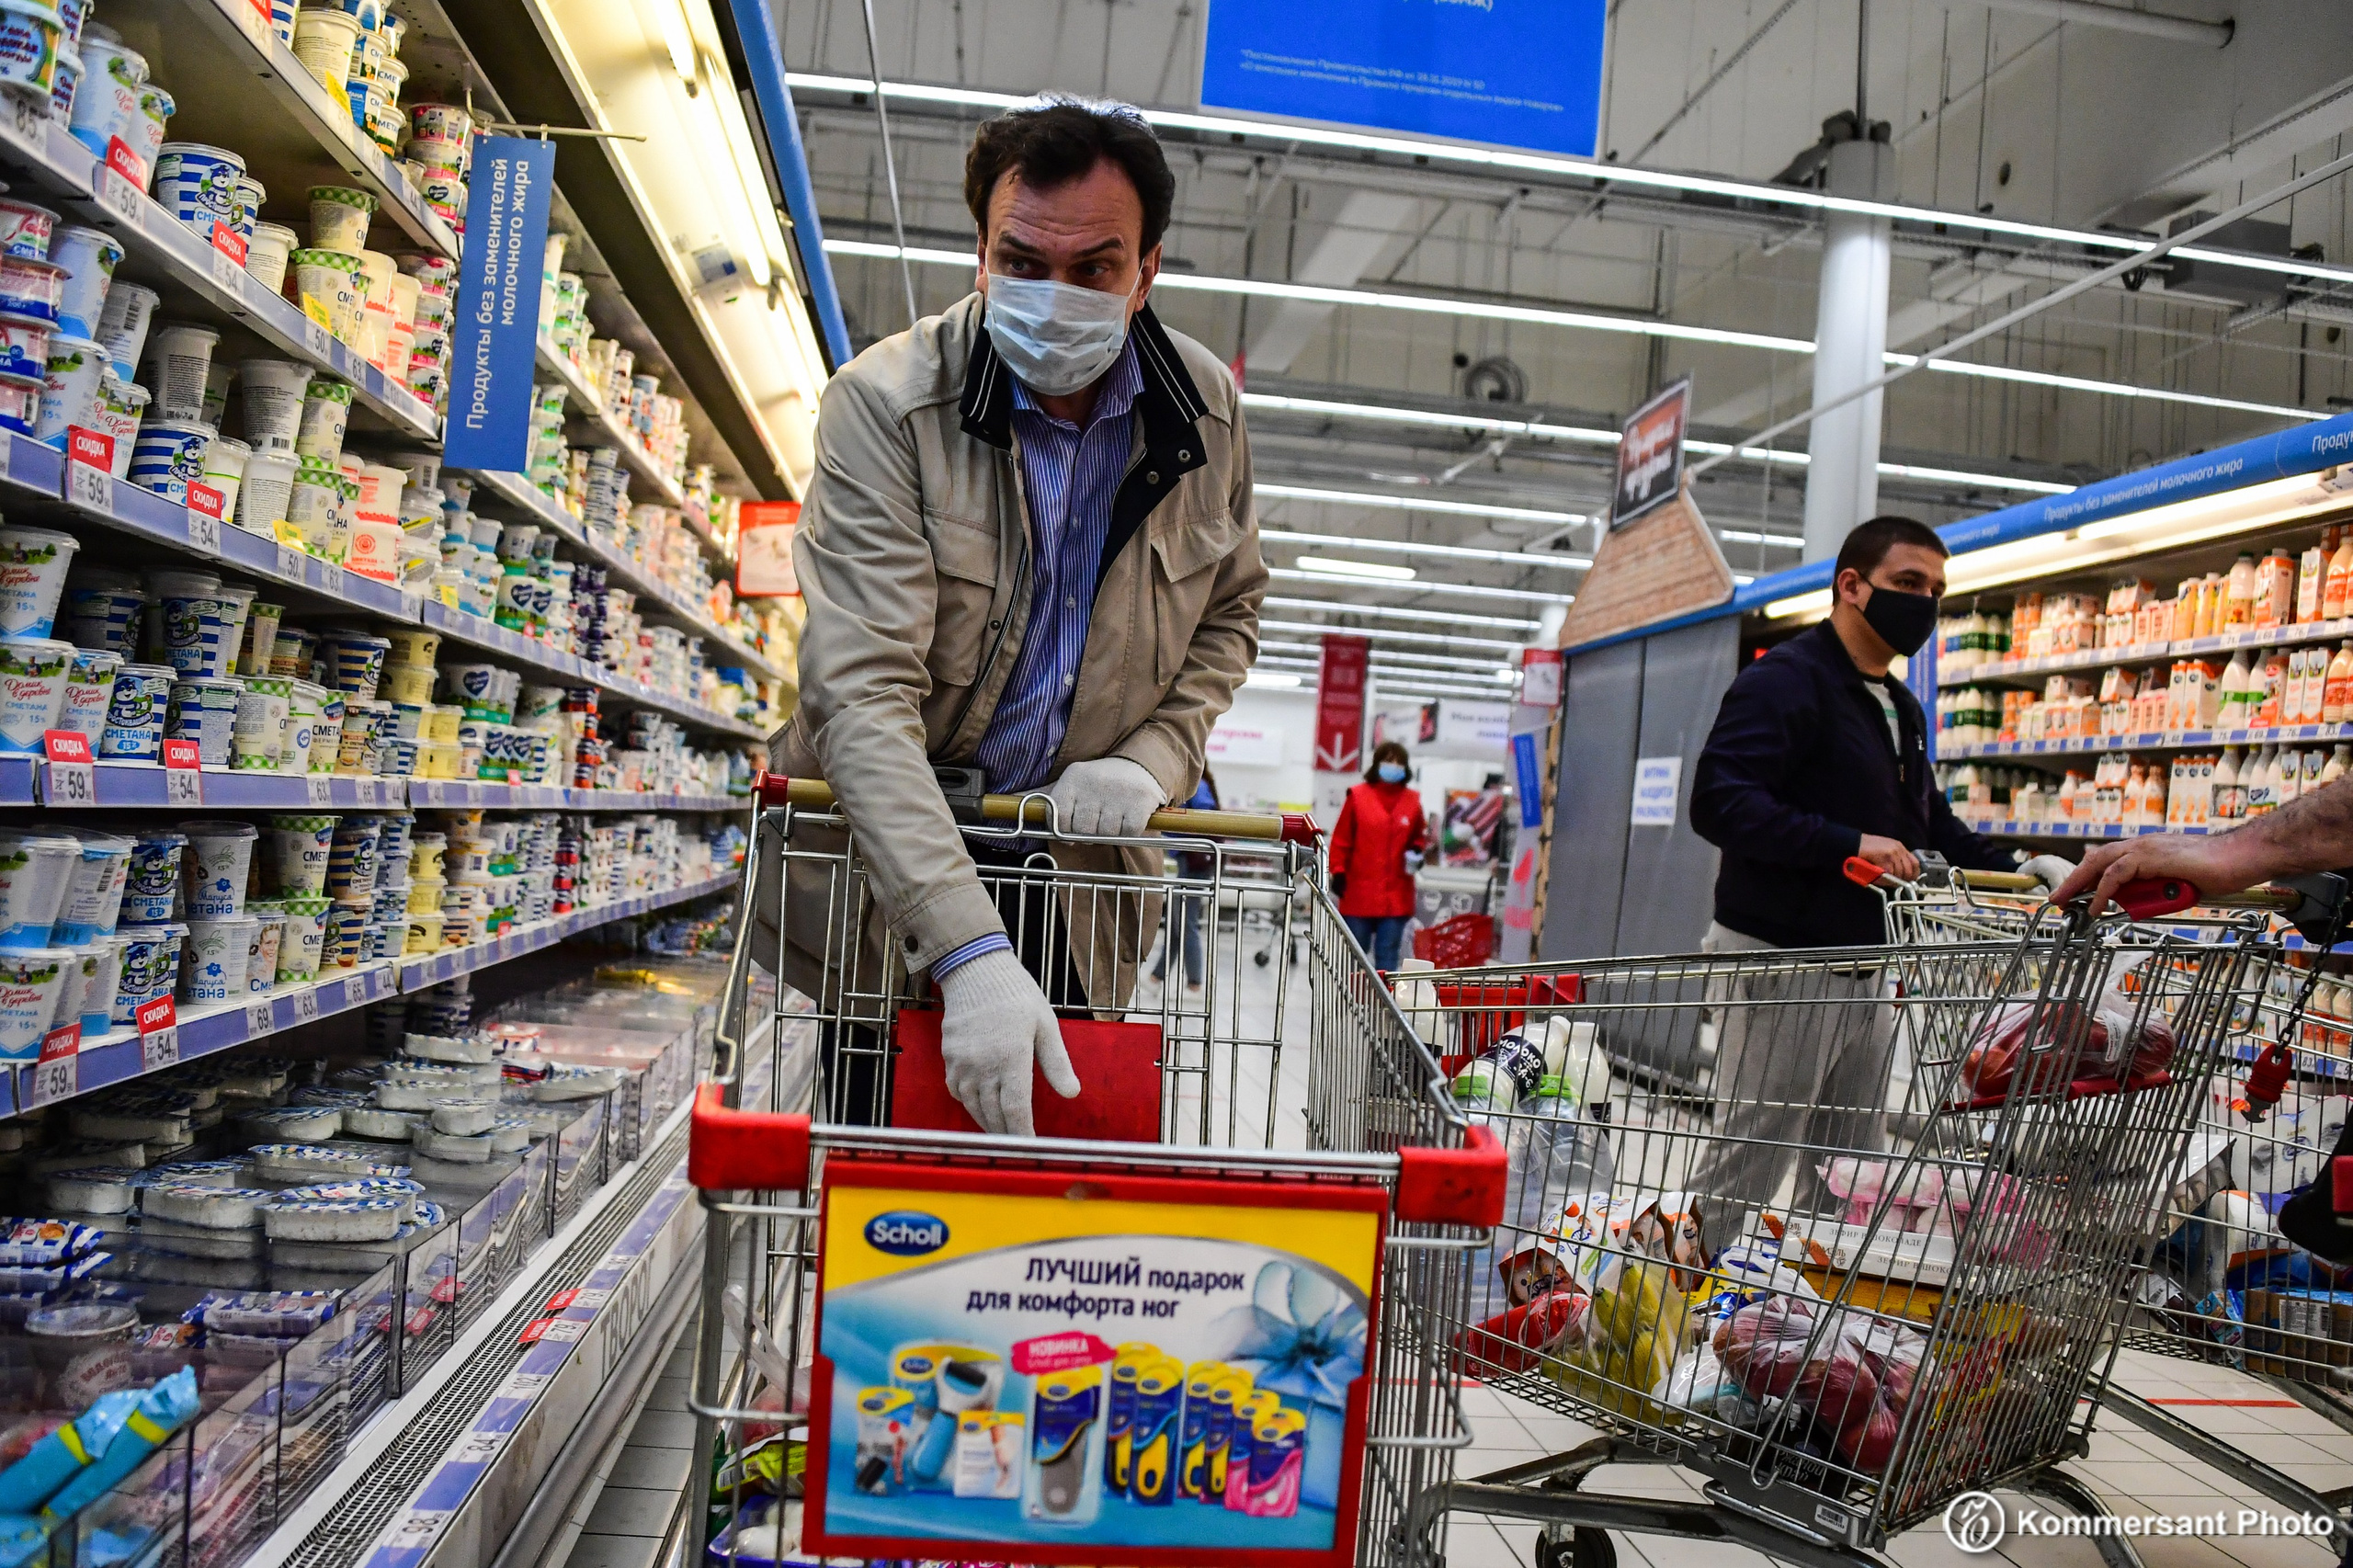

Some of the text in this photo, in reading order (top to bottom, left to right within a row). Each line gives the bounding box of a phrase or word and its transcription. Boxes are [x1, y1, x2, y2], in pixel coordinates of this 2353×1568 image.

[115, 148, 142, 177] СКИДКА
[120, 187, 138, 220] 59
[219, 231, 242, 257] СКИДКА
[501, 160, 531, 325] молочного жира
[466, 159, 508, 429] Продукты без заменителей
[314, 328, 326, 354] 50
[76, 436, 106, 457] СКИДКА
[88, 473, 104, 505] 59
[193, 490, 218, 510] СКИДКА
[2044, 458, 2244, 525] Продукты без заменителей молочного жира
[200, 520, 214, 548] 54
[5, 679, 42, 693] Домик
[19, 687, 51, 700] деревне
[65, 686, 100, 699] Домик
[52, 737, 84, 756] СКИДКА
[105, 728, 152, 741] СМЕТАНА
[171, 746, 195, 764] СКИДКА
[68, 770, 85, 800] 59
[179, 775, 194, 800] 54
[143, 1003, 171, 1025] СКИДКА
[302, 994, 313, 1016] 63
[257, 1007, 268, 1030] 69
[47, 1032, 74, 1053] СКИДКА
[157, 1035, 172, 1062] 54
[50, 1064, 67, 1096] 59
[872, 1219, 943, 1247] Scholl
[1025, 1256, 1246, 1297] ЛУЧШИЙ подарок
[966, 1290, 1181, 1321] для комфорта ног
[1028, 1337, 1090, 1356] НОВИНКА
[467, 1437, 501, 1452] 84
[402, 1517, 440, 1535] 98
